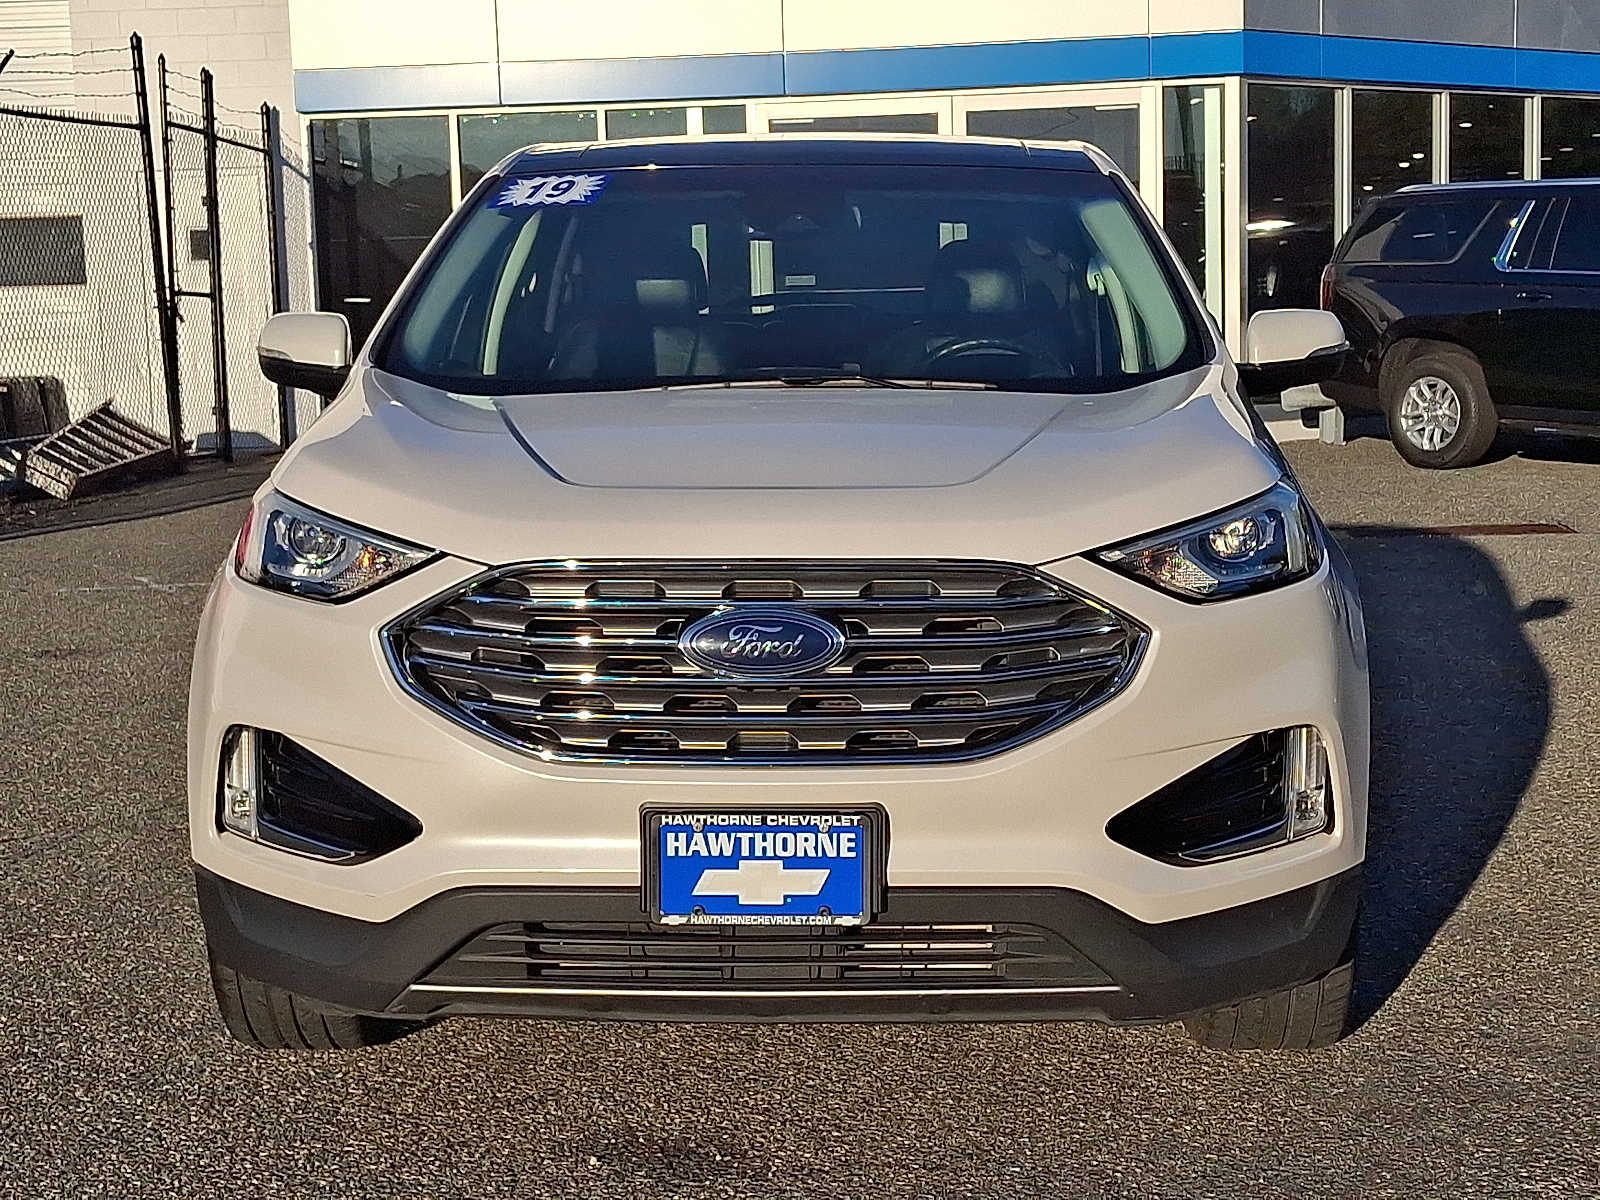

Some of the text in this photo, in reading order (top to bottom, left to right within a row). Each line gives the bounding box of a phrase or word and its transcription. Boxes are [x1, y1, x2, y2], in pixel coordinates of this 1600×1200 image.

[526, 180, 577, 199] 19
[721, 624, 804, 658] Ford
[661, 815, 861, 827] HAWTHORNE CHEVROLET
[666, 832, 857, 858] HAWTHORNE
[690, 915, 832, 925] HAWTHORNECHEVROLET.COM
